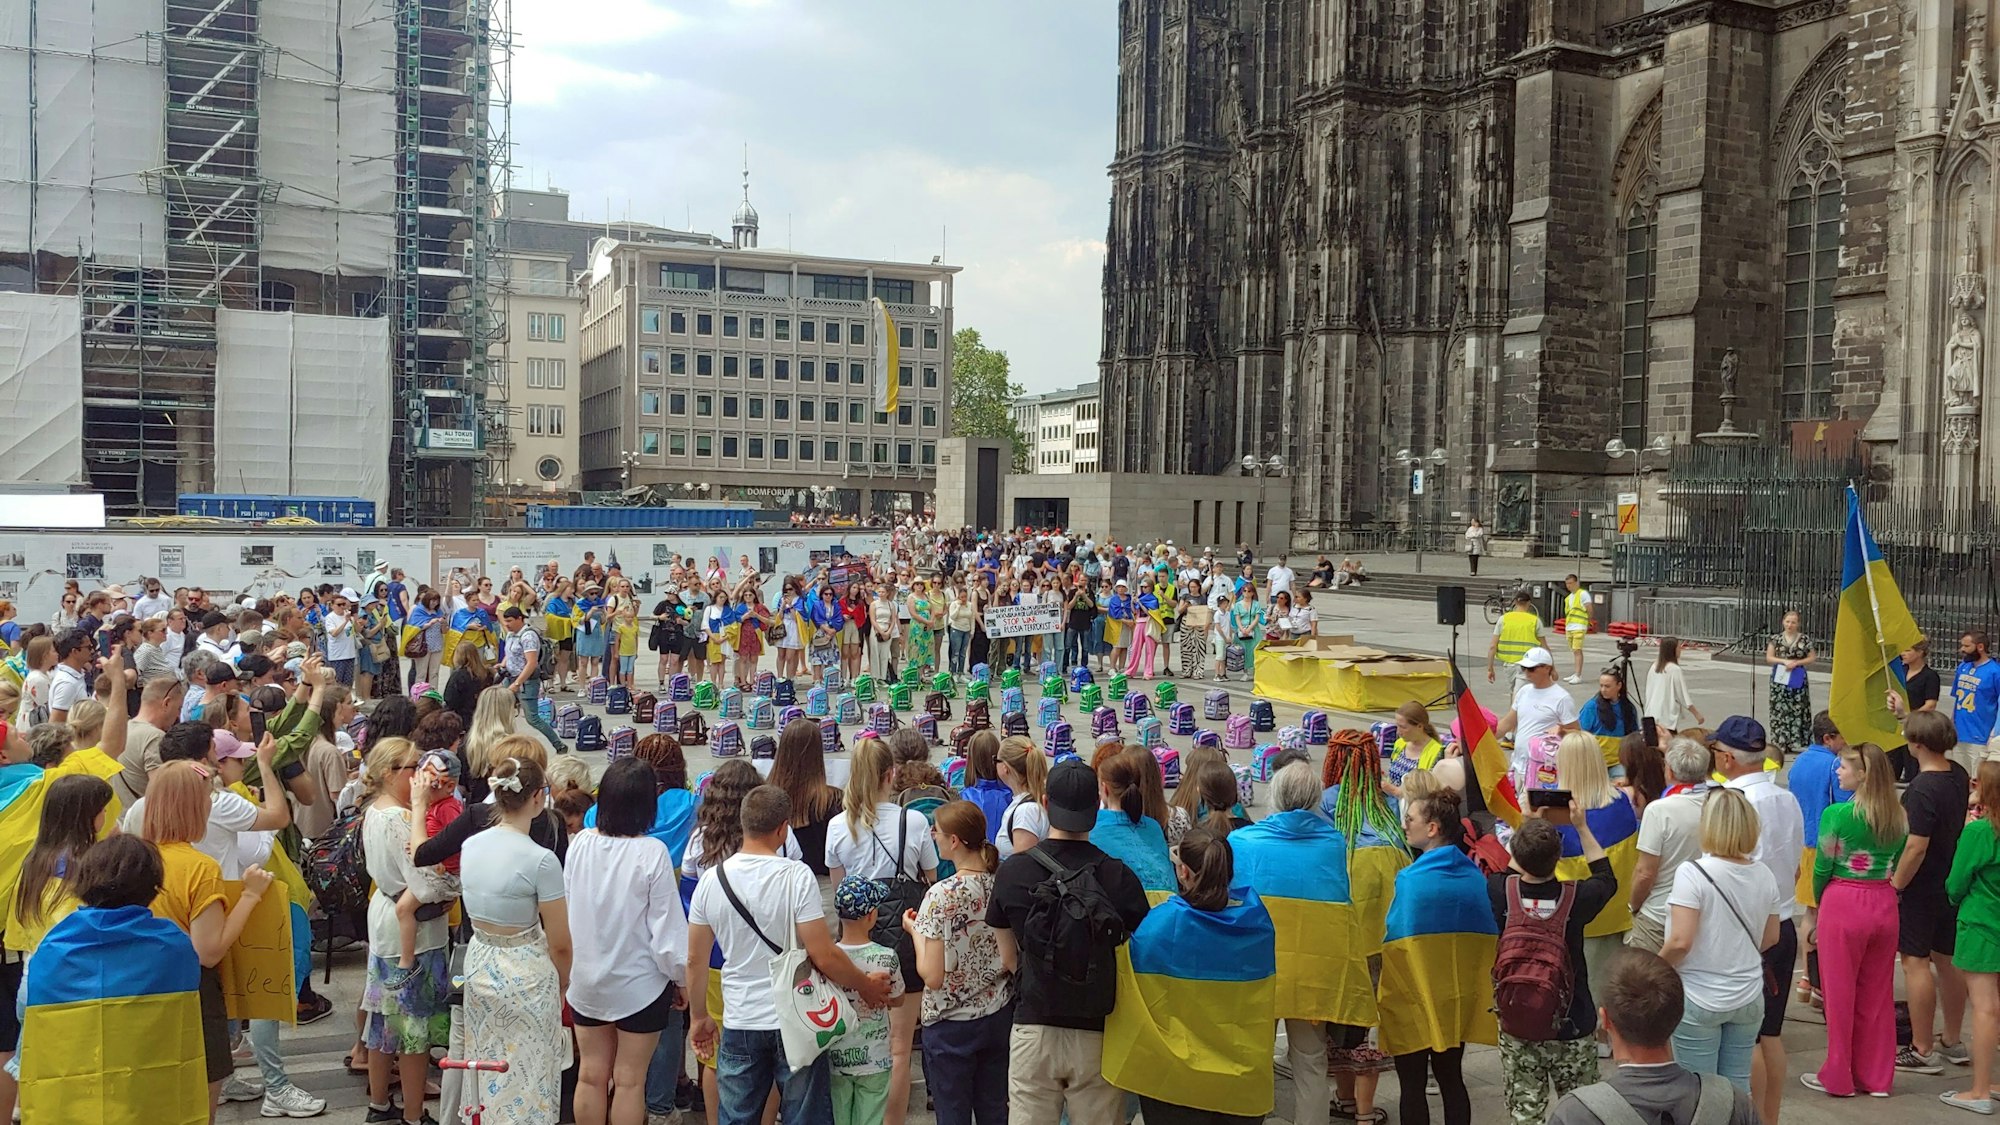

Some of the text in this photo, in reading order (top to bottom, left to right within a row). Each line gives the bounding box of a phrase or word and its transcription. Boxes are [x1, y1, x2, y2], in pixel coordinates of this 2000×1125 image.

[747, 488, 795, 496] DOMFORUM
[1003, 617, 1019, 625] STOP
[1004, 625, 1023, 633] RUSSIA
